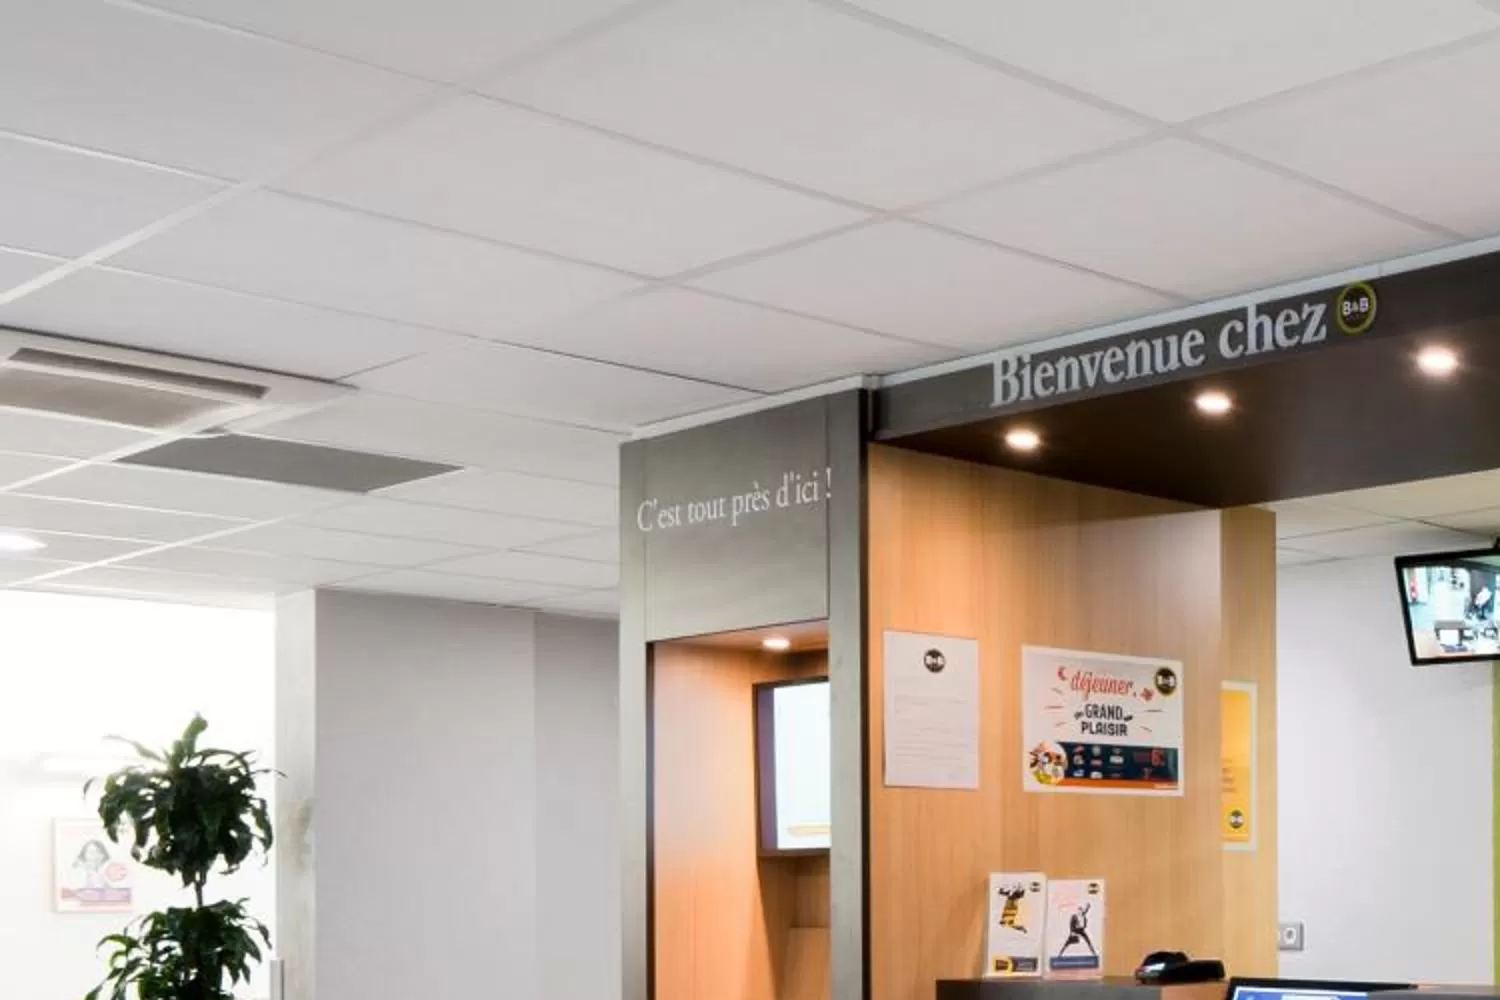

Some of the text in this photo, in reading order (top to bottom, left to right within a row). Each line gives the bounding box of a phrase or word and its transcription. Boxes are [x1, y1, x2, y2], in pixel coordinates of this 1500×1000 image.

[990, 303, 1327, 408] Bienvenue chez
[637, 467, 832, 532] C'est tout près d'ici !
[1081, 721, 1128, 737] PLAISIR
[1085, 703, 1123, 721] GRAND
